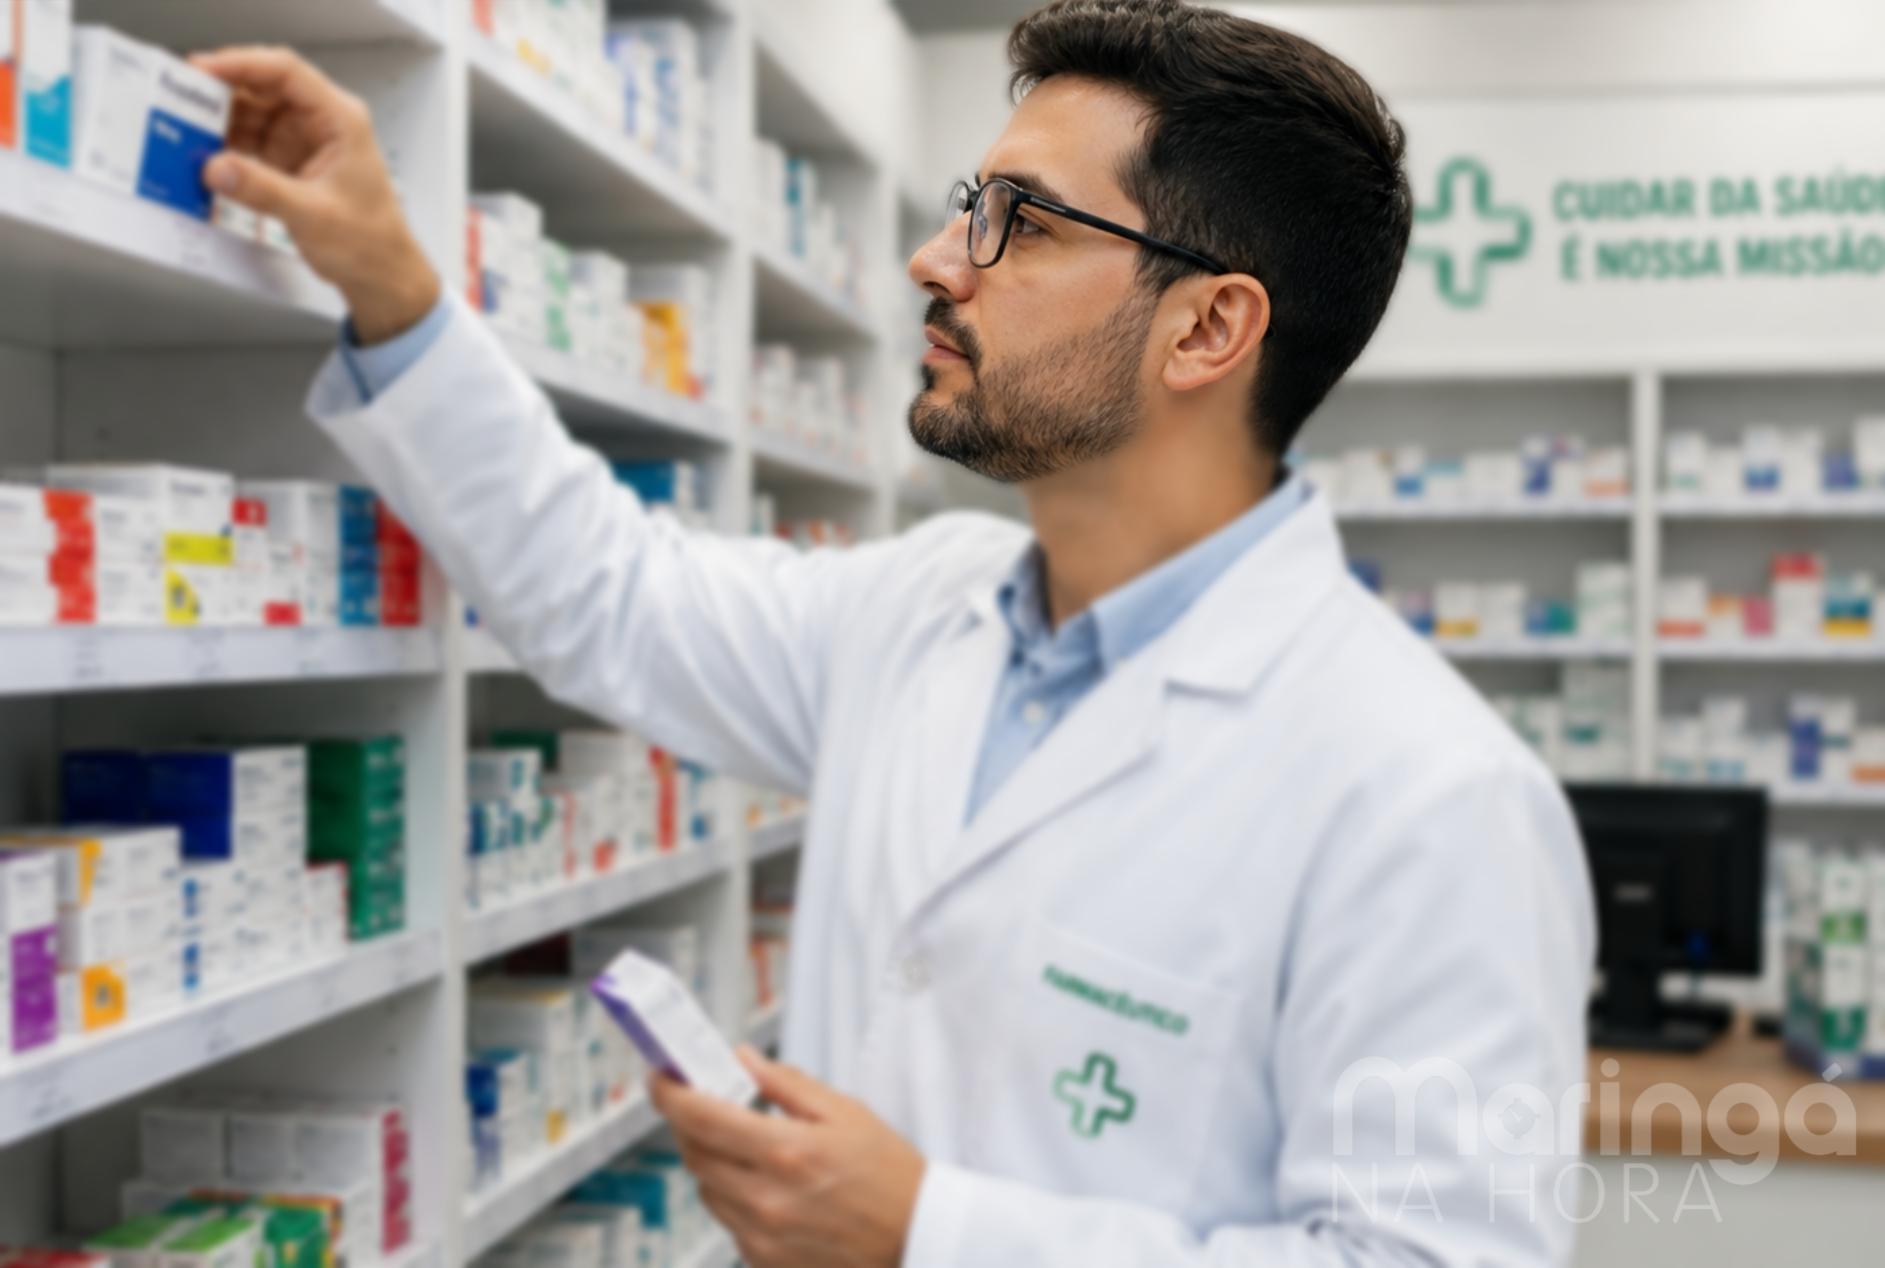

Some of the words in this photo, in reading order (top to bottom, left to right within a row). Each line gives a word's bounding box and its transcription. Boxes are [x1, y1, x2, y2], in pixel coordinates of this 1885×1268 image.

[1554, 178, 1697, 219] CUIDAR
[1708, 177, 1760, 216] DA
[1775, 164, 1885, 215] SAÚD
[1595, 238, 1722, 279] NOSSA
